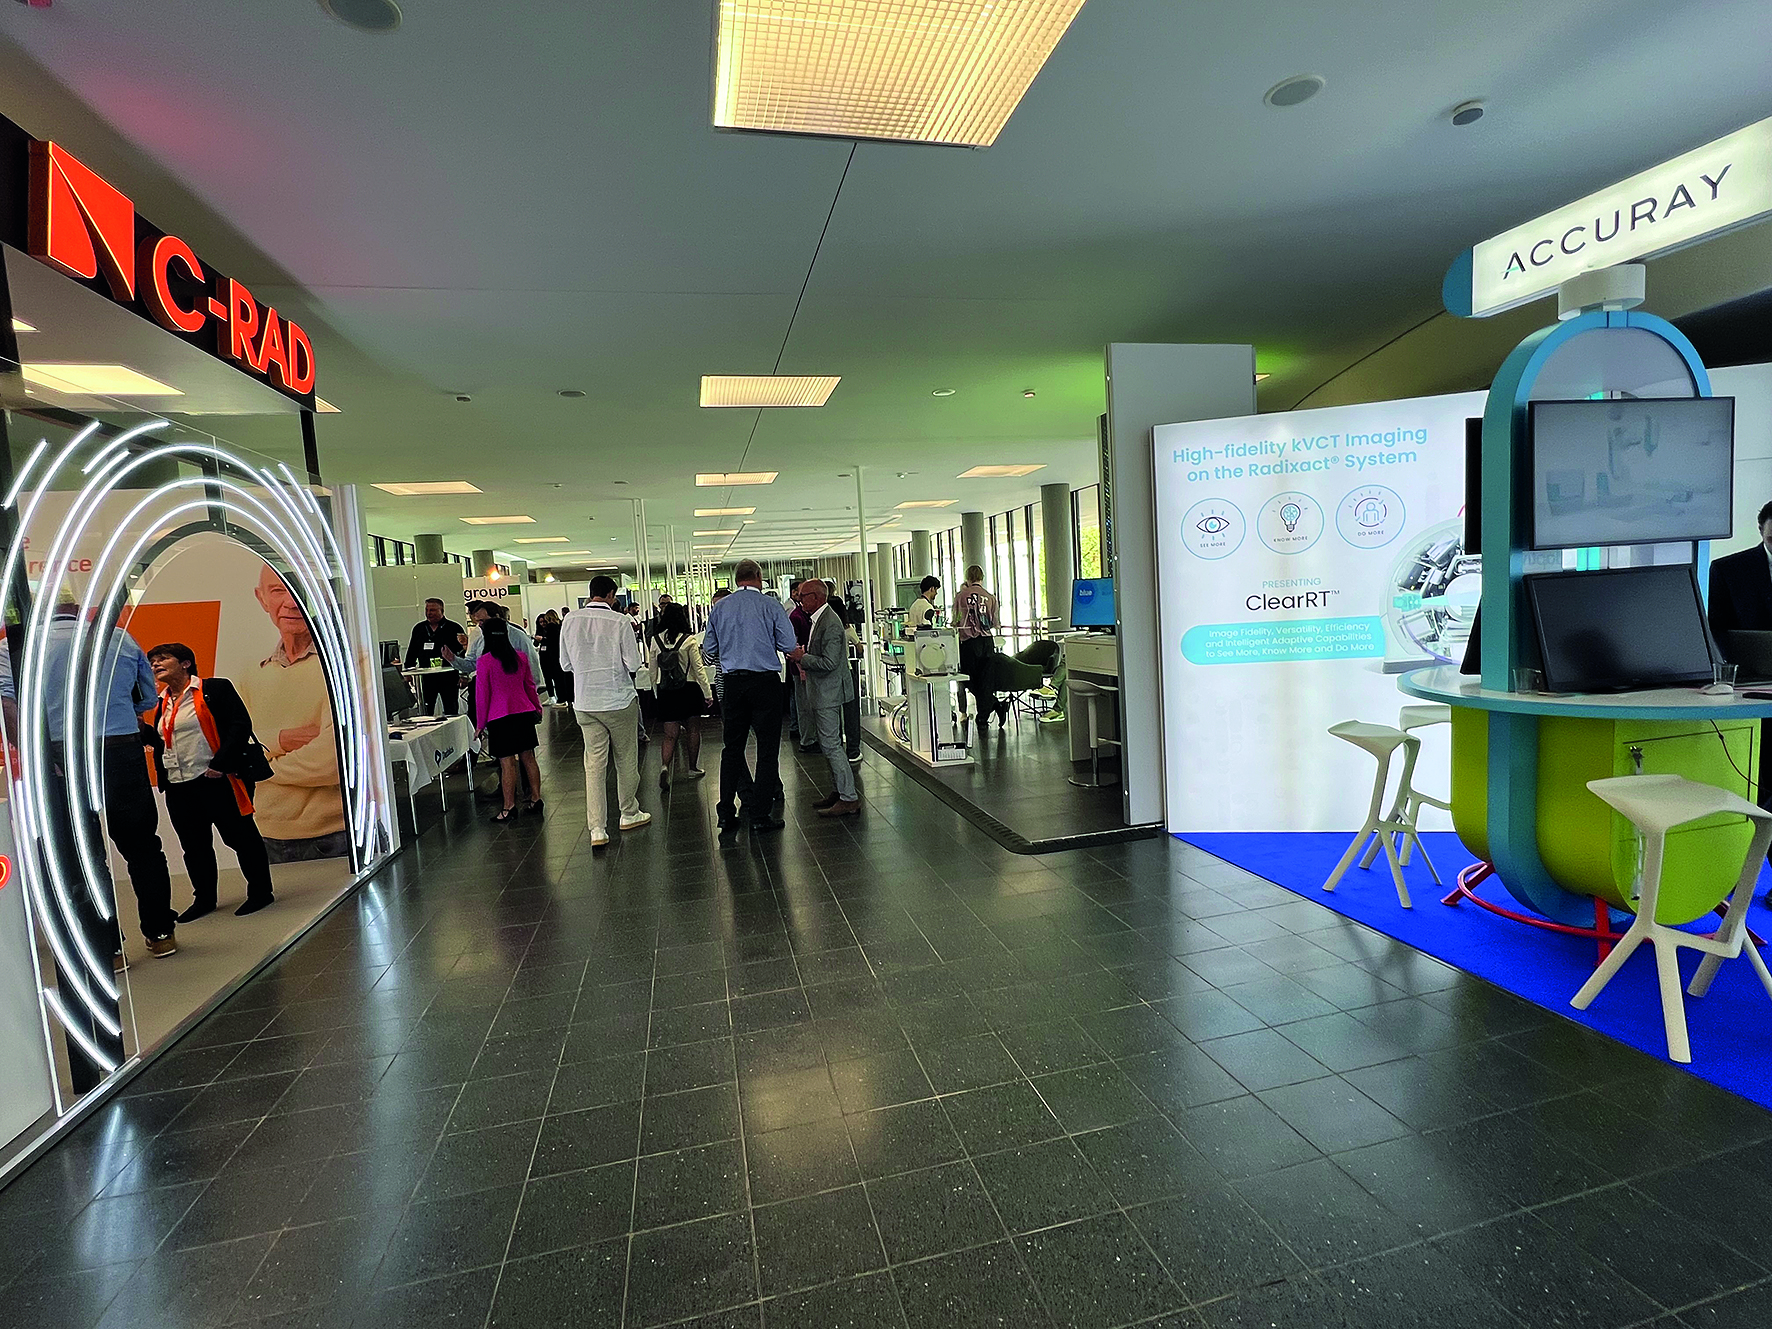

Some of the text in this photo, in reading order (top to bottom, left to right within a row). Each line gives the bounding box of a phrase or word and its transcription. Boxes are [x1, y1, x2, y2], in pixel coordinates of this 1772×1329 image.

[1501, 163, 1732, 280] ACCURAY
[146, 235, 315, 395] C-RAD
[1173, 427, 1428, 466] High-fidelity kVCT Imaging
[1187, 470, 1209, 482] on
[1214, 465, 1244, 479] the
[1345, 451, 1417, 472] System
[1262, 577, 1322, 589] PRESENTING
[463, 587, 508, 601] group
[1209, 622, 1371, 639] Image Fidelity, Versatility, Efficiency
[1205, 632, 1372, 648] and Intelligent Adaptive Capabilities
[1205, 642, 1375, 658] to See More, Know More and Do More
